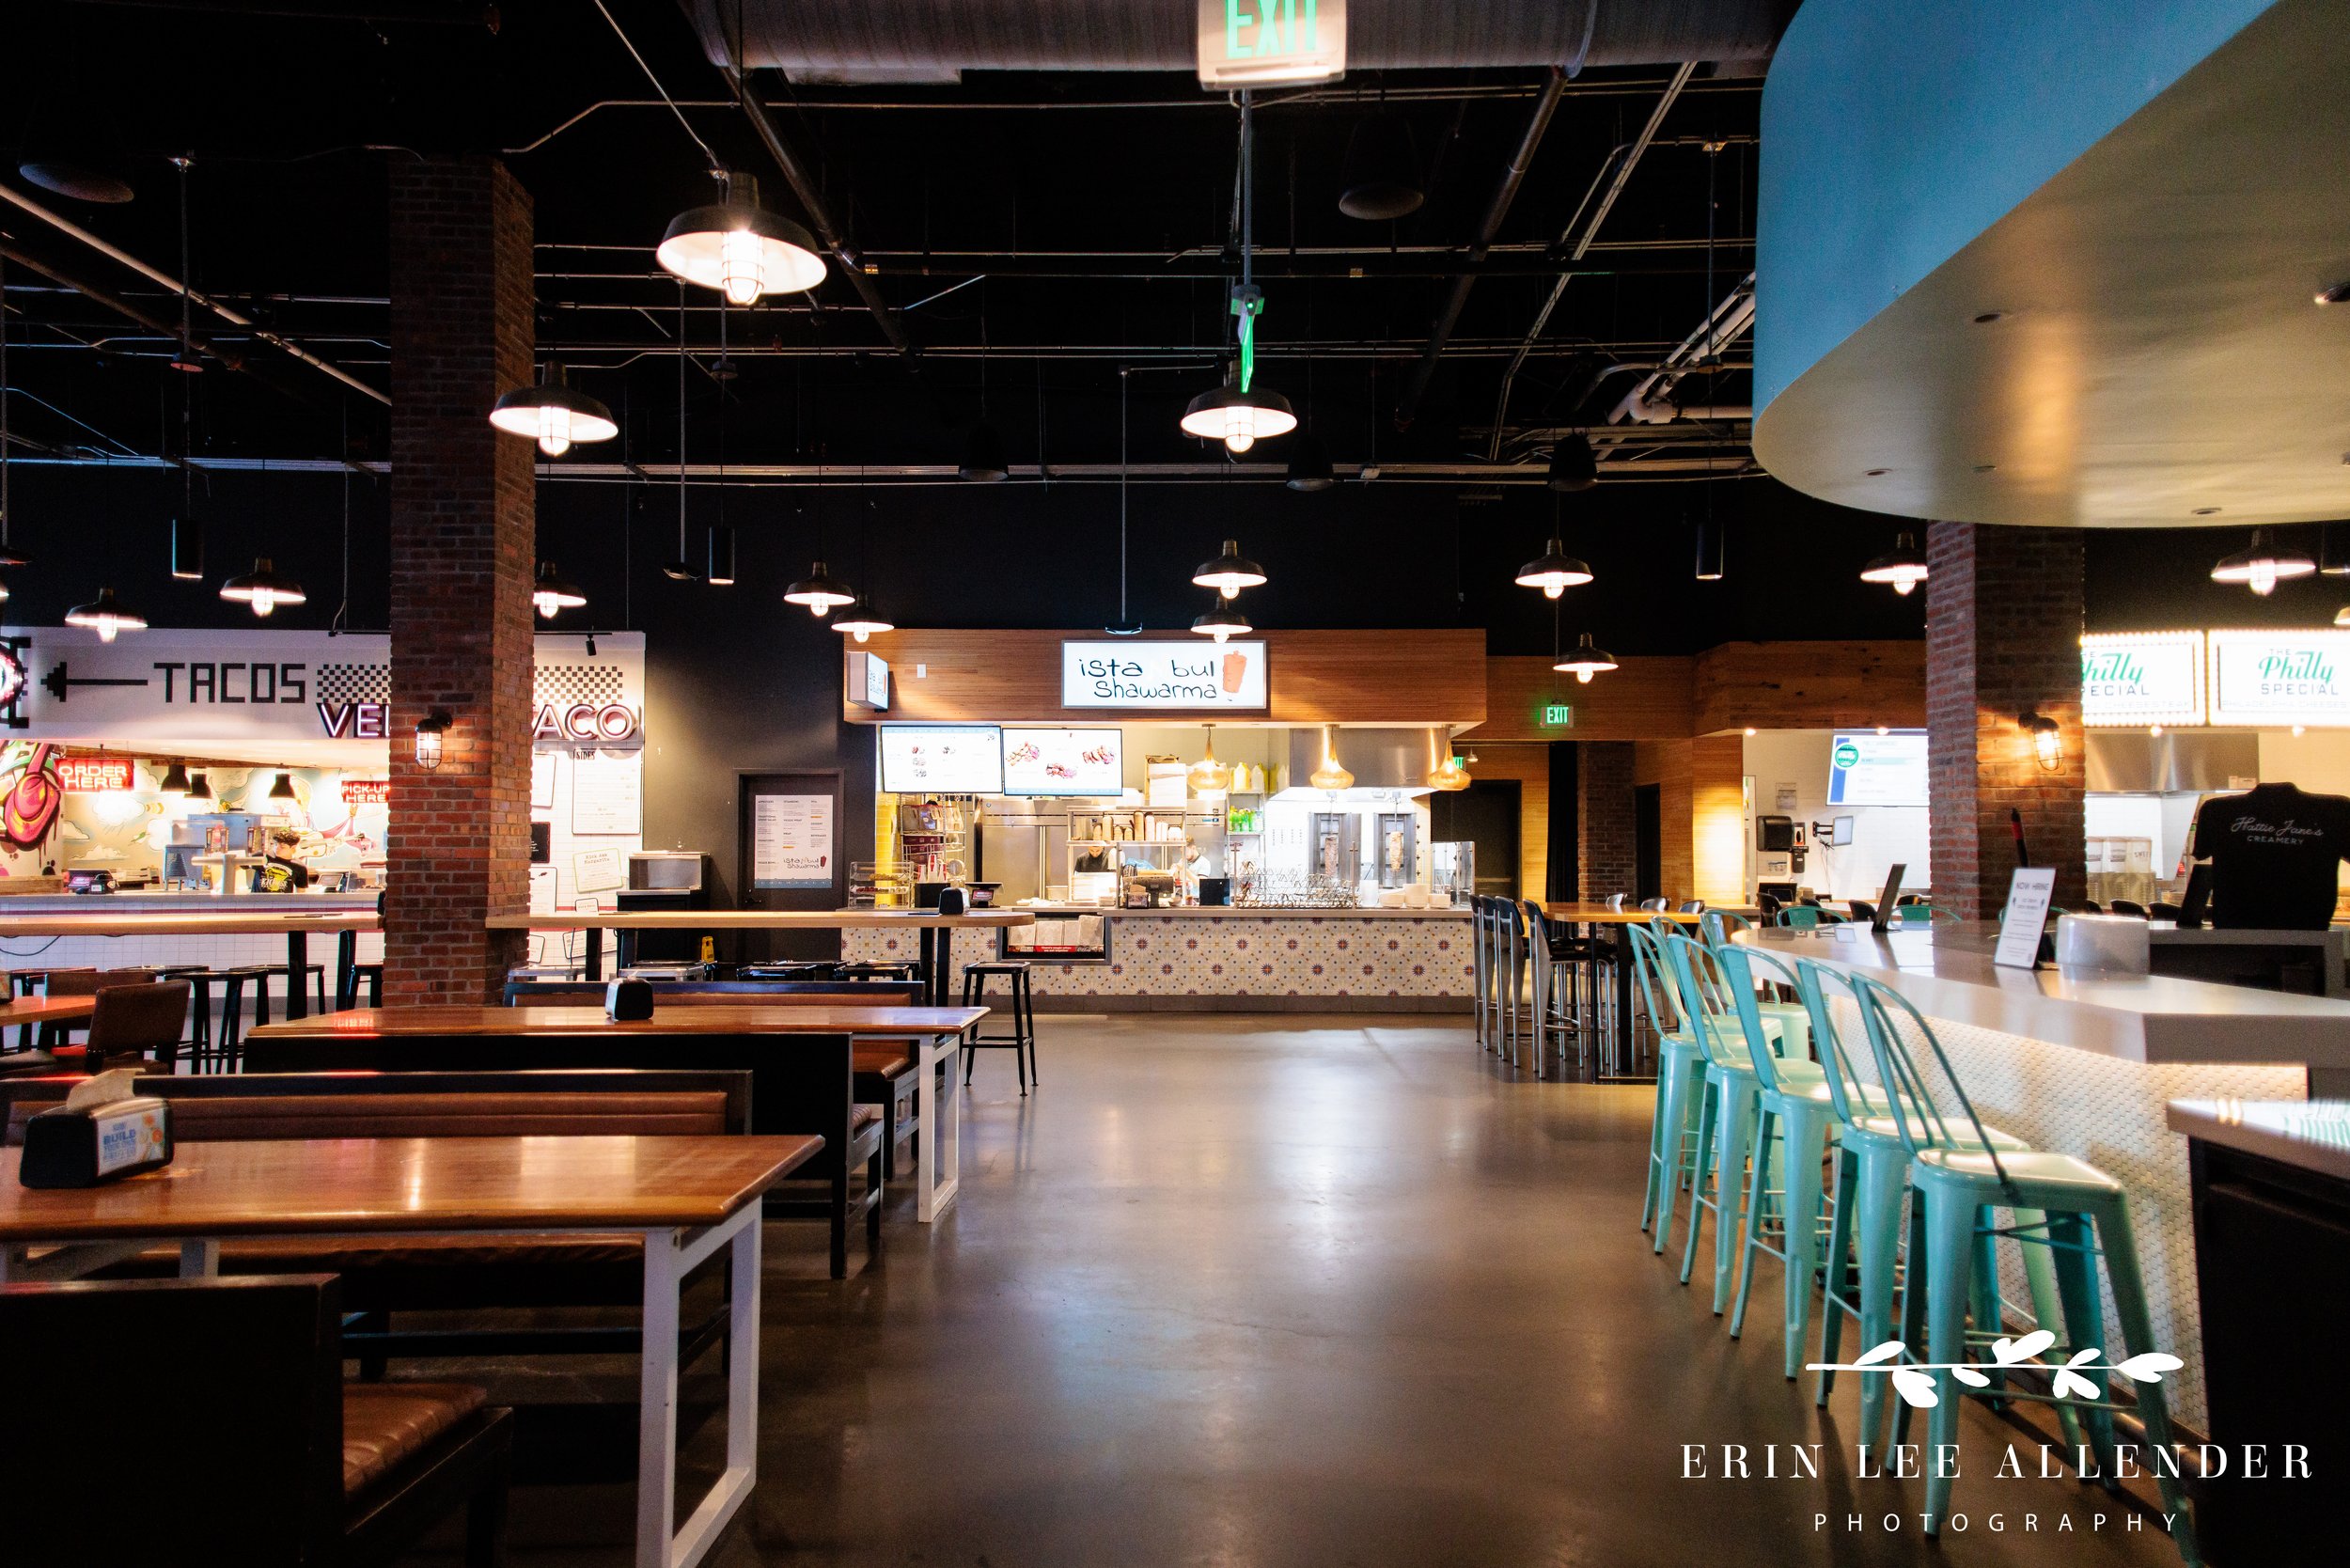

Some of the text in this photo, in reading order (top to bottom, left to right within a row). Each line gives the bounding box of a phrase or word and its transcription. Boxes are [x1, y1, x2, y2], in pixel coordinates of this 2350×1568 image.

[1171, 659, 1215, 677] bul
[2081, 652, 2145, 685] hilly
[2258, 651, 2335, 684] Philly
[153, 663, 306, 703] TACOS
[1093, 678, 1217, 698] Shawarma
[2081, 684, 2150, 697] ECIAL
[2261, 683, 2339, 695] SPECIAL
[532, 703, 637, 741] ACO
[1546, 706, 1569, 724] EXIT
[58, 765, 128, 776] ORDER
[64, 776, 123, 789] HERE
[341, 785, 390, 794] PICK-UP
[345, 794, 386, 803] HERE
[2231, 816, 2325, 837] Hattie Jane's
[2247, 835, 2305, 845] CREAMERY
